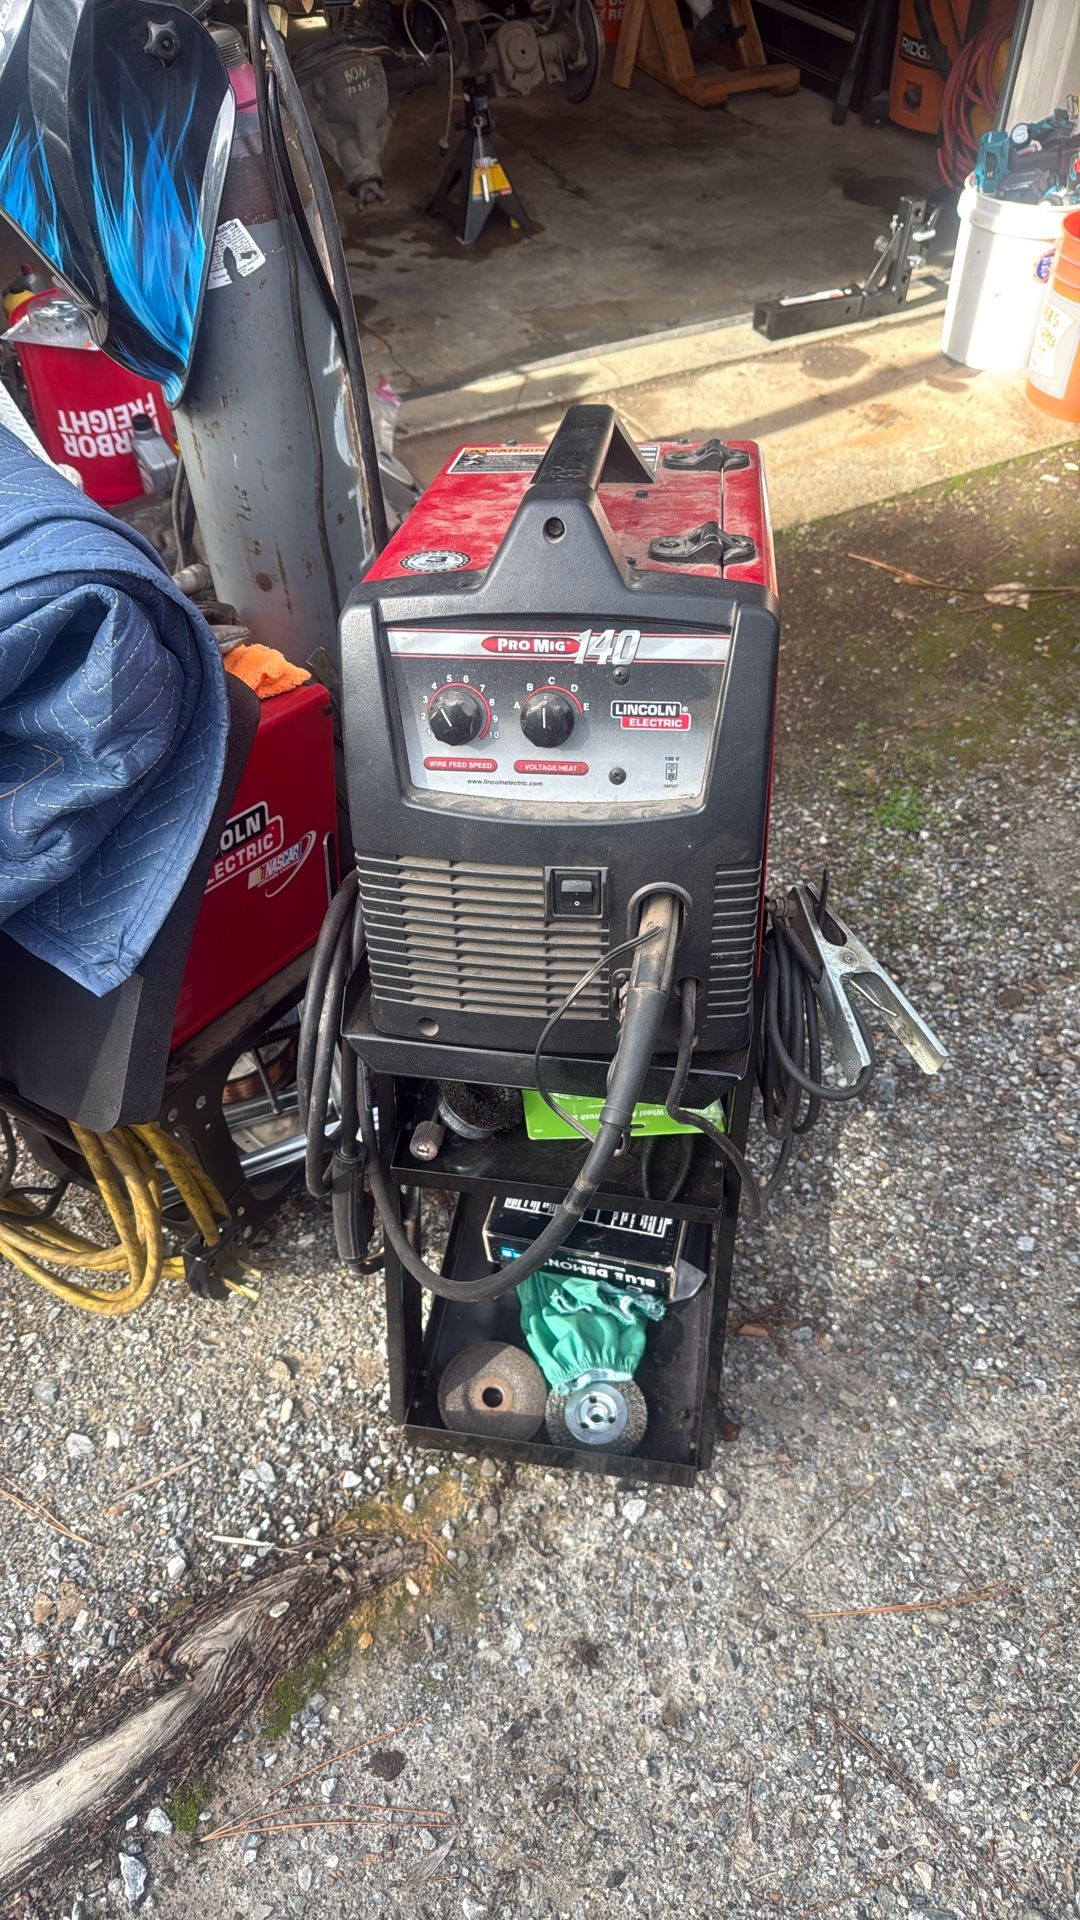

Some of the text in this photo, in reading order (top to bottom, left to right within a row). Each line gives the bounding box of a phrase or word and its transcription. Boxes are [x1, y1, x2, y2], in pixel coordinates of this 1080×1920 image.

[216, 221, 236, 235] ixture
[498, 629, 641, 665] PRO MIG 140
[446, 675, 453, 683] 5
[462, 675, 470, 683] 6
[431, 682, 437, 690] 4
[479, 684, 486, 692] 7
[513, 676, 590, 711] A B C D E
[423, 695, 429, 704] 3
[489, 698, 495, 706] 8
[615, 703, 677, 716] LINCOLN
[420, 712, 427, 720] 2
[492, 715, 498, 723] 9
[628, 718, 683, 728] ELECTRIC
[489, 731, 500, 739] 10
[448, 761, 467, 769] FEED
[469, 762, 493, 770] SPEED
[524, 764, 578, 772] VOLTAGE/HEAT
[467, 778, 543, 787] www.lincolnelectric.com
[216, 812, 261, 856] OLN
[207, 832, 274, 887] ECTRIC
[265, 840, 302, 879] NASCAR
[639, 1109, 664, 1118] Wheel
[548, 1258, 656, 1288] BLUE DEMON
